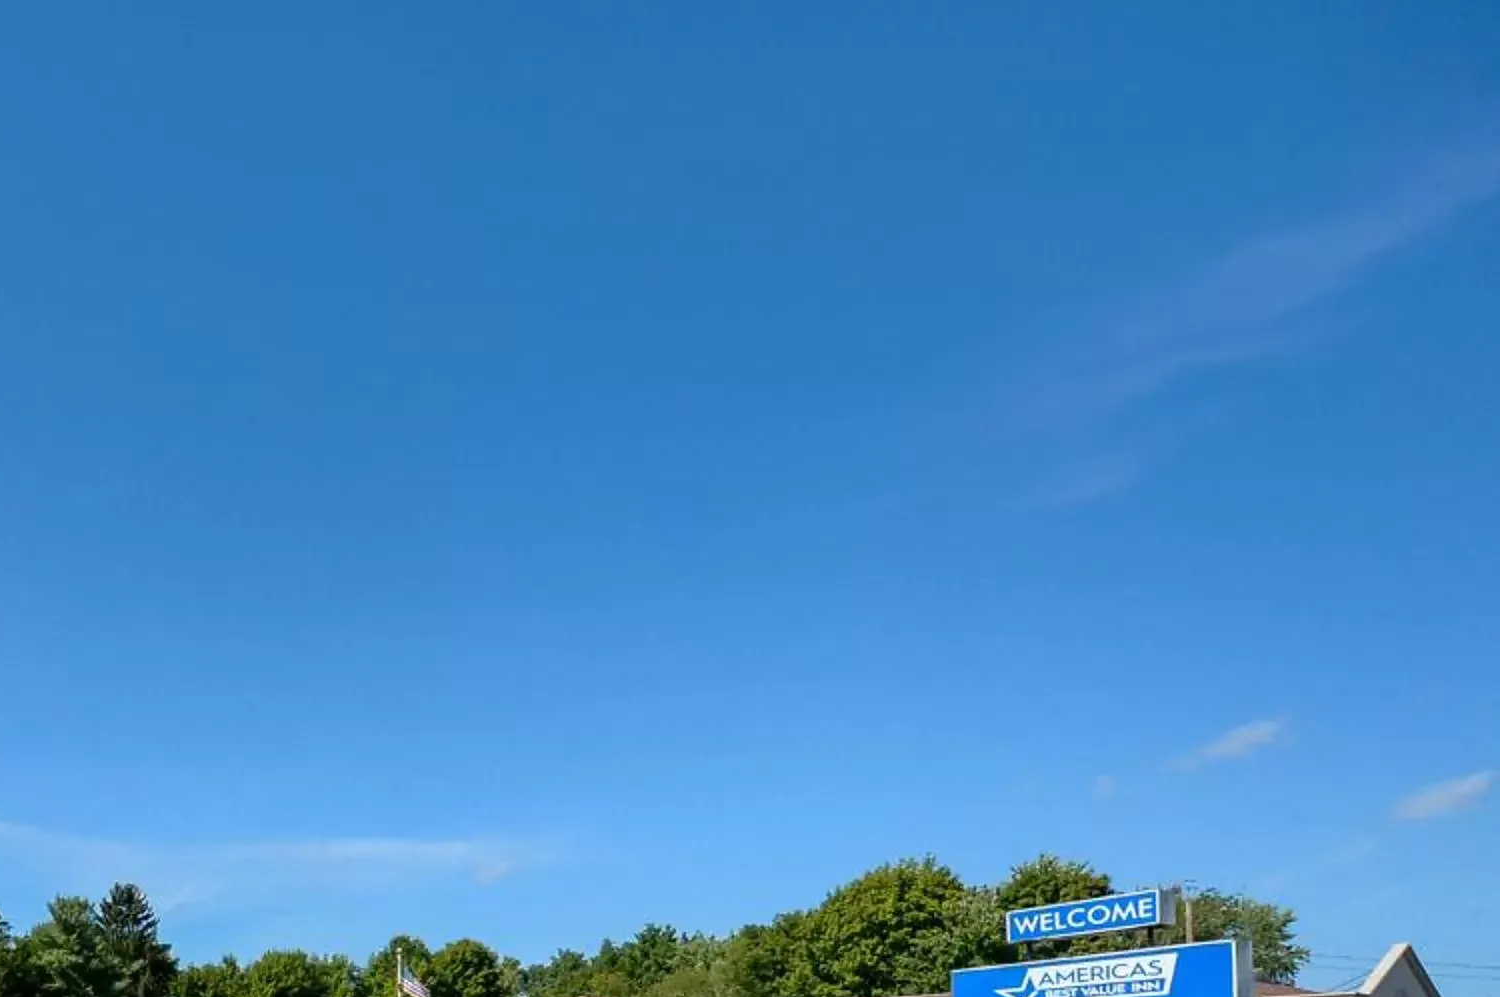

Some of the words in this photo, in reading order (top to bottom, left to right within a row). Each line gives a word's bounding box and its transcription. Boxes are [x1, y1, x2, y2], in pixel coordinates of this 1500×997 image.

[1013, 899, 1153, 933] WELCOME
[1039, 959, 1163, 986] AMERICAS
[1082, 982, 1125, 997] VALUE
[1130, 979, 1162, 994] INN
